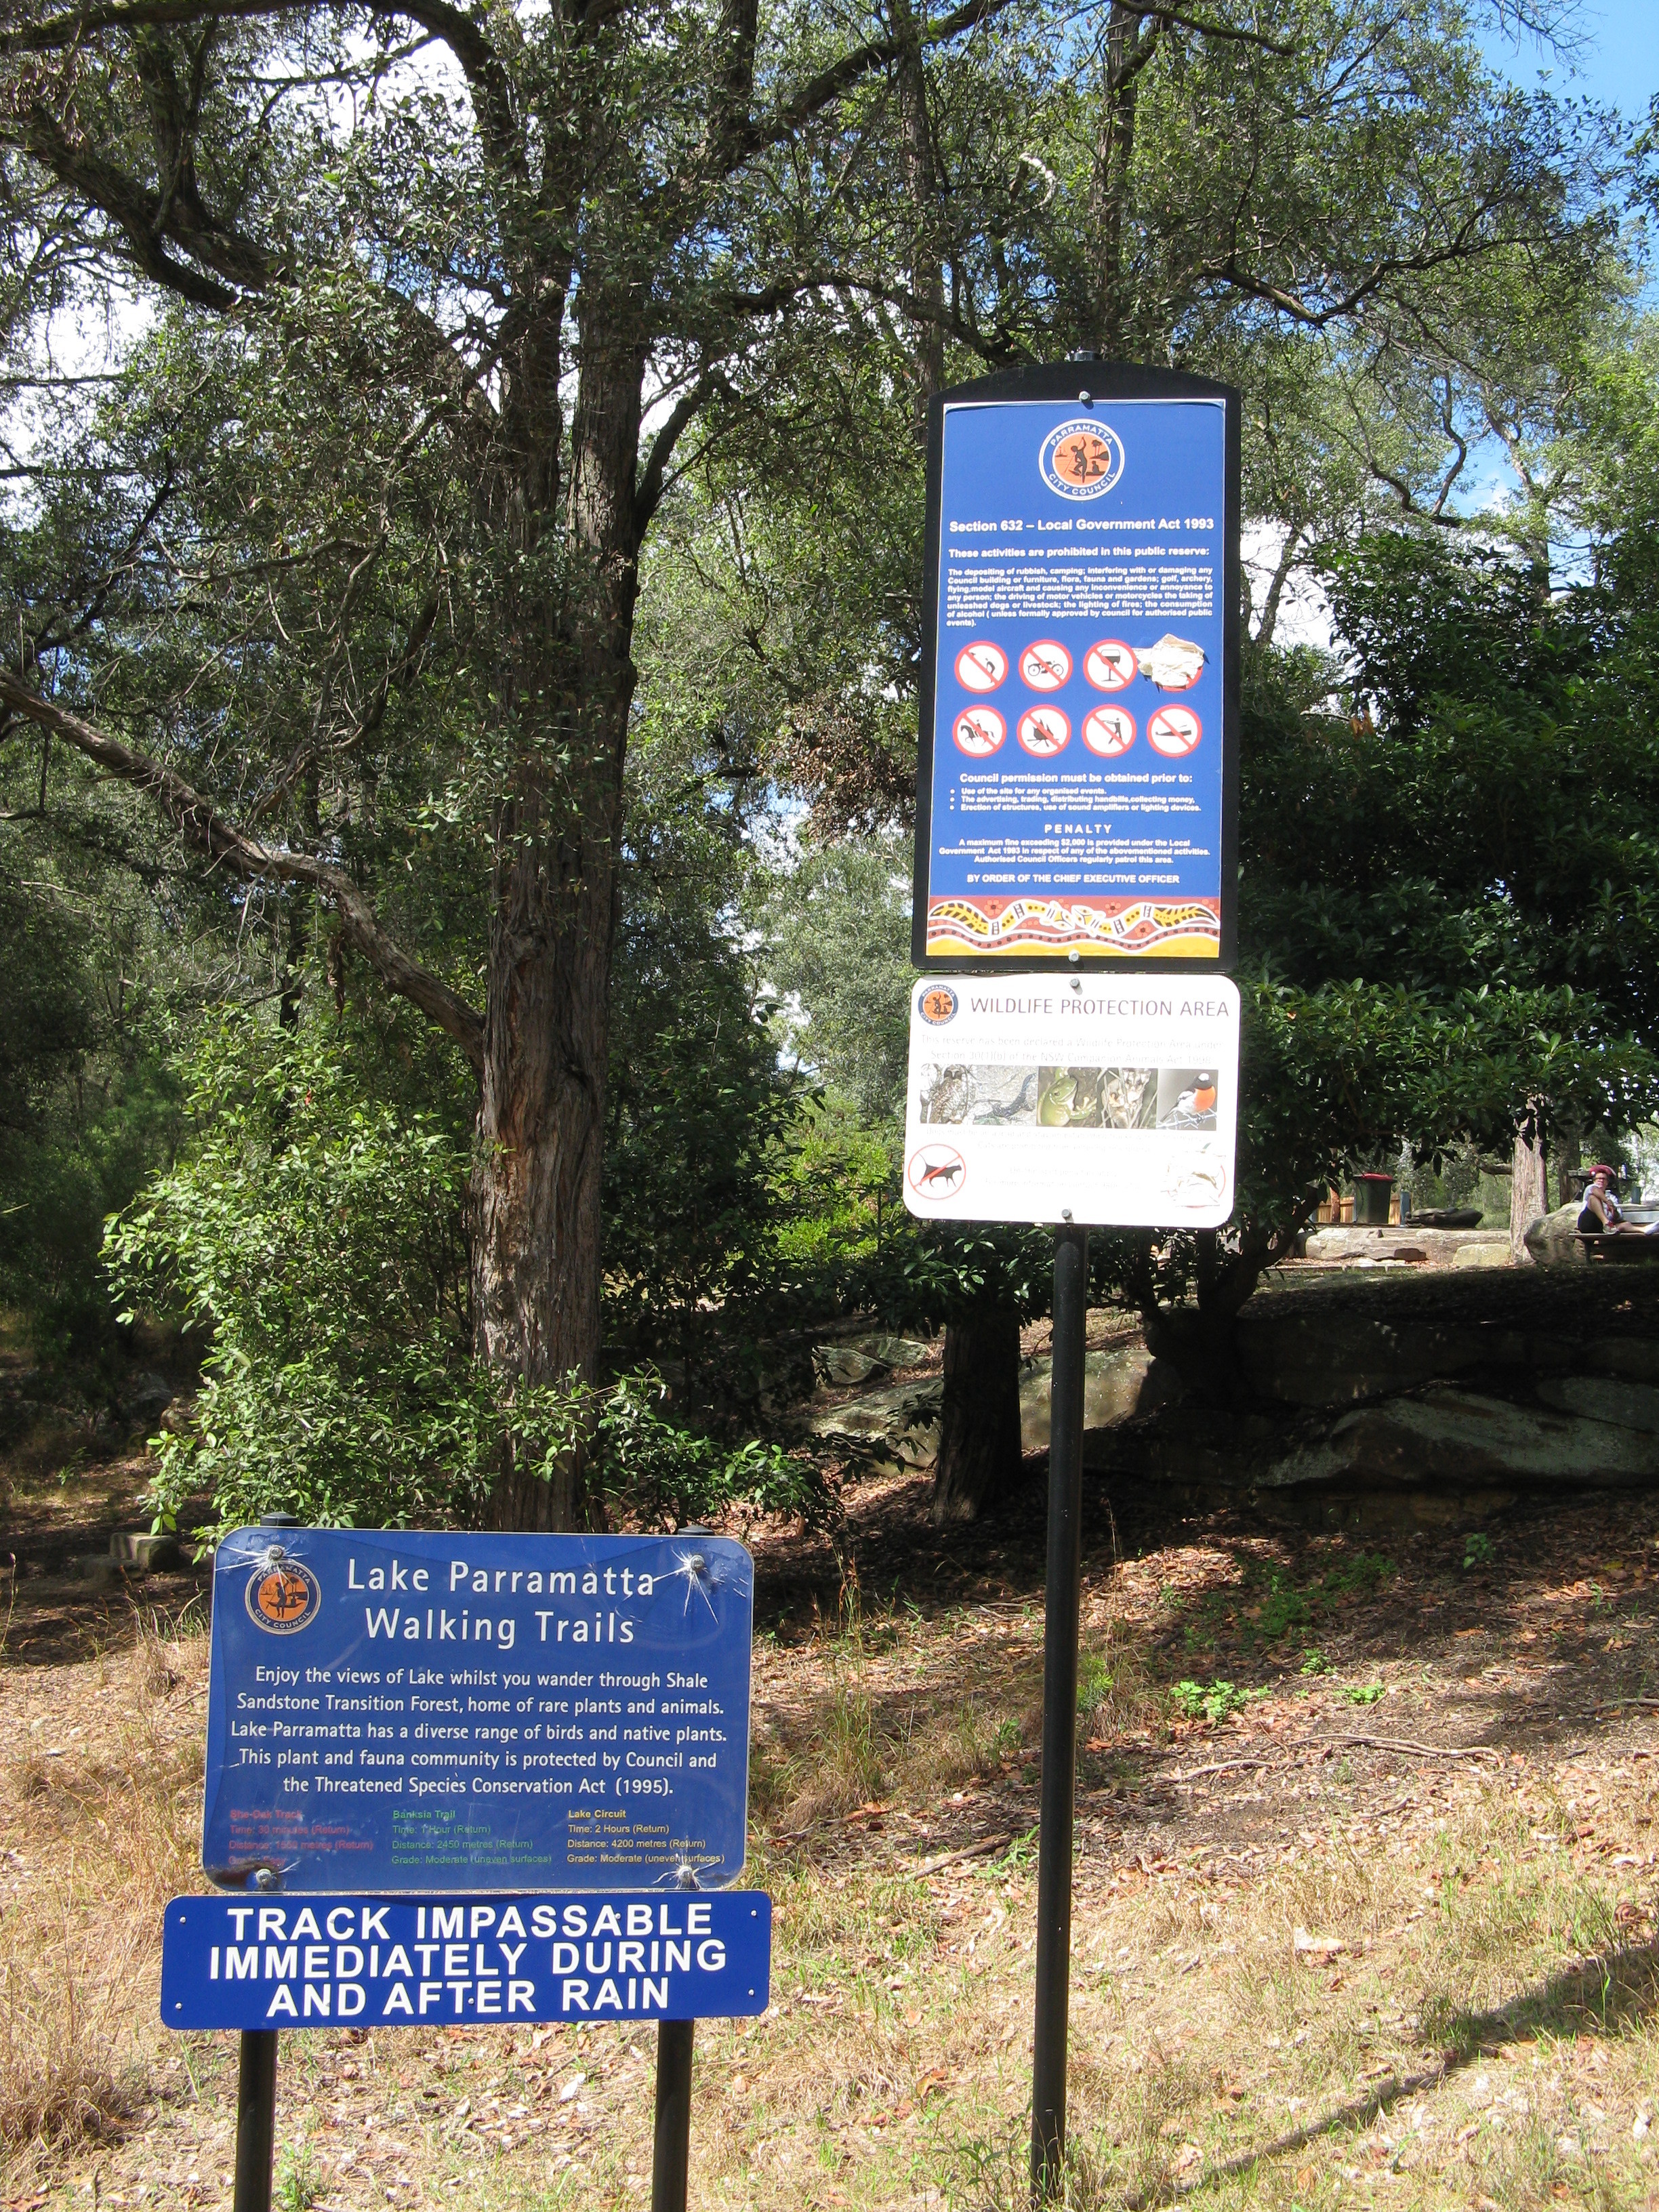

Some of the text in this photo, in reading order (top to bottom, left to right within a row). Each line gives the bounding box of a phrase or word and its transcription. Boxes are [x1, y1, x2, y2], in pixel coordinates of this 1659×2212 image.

[1049, 424, 1113, 447] PARRAMATTA
[1048, 472, 1116, 495] CITY COUNCIL
[949, 520, 997, 532] Section
[1000, 519, 1023, 531] 632
[1038, 518, 1072, 530] Local
[1076, 518, 1155, 530] Government
[1158, 518, 1180, 529] Act
[1184, 518, 1214, 529] 1993
[948, 548, 979, 558] These
[981, 548, 1025, 557] activities
[1046, 546, 1098, 558] prohibited
[1101, 546, 1110, 556] in
[1112, 546, 1132, 556] this
[1134, 546, 1166, 557] public
[964, 568, 1005, 577] depositing
[1087, 566, 1128, 575] interfering
[1158, 566, 1197, 575] damaging
[960, 773, 1192, 784] Council permission must be obtained prior to:
[1044, 823, 1111, 834] PENALTY
[966, 874, 1180, 883] BY ORDER OF THE CHIEF EXECUTIVE OFFICER
[970, 998, 1229, 1016] WILDLIFE PROTECTION AREA
[348, 1558, 655, 1596] Lake Parramatta
[255, 1608, 312, 1629] CITY COUNCIL
[365, 1607, 634, 1650] Walking Trails
[255, 1666, 708, 1691] Enjoy the views of Lake whilst you wander through Shale
[237, 1692, 723, 1717] Sandstone Transition Forest, home of rare plants and animals.
[231, 1720, 726, 1744] Lake Parramatta has a diverse range of birds and native plants.
[239, 1748, 716, 1771] This plant and fauna community is protected by Council and
[283, 1775, 673, 1797] the Threatened Species Conservation Act (1995).
[392, 1809, 455, 1820] Banksia Trail
[568, 1809, 626, 1818] Lake Circuit
[568, 1824, 669, 1835] Time: 2 Hours (Return)
[567, 1839, 705, 1850] Distance: 4200 metres (Return)
[567, 1853, 597, 1862] Grade:
[600, 1853, 642, 1862] Moderate
[227, 1904, 712, 1940] TRACK IMPASSABLE
[210, 1938, 725, 1980] IMMEDIATELY DURING
[266, 1977, 668, 2017] AND AFTER RAIN
